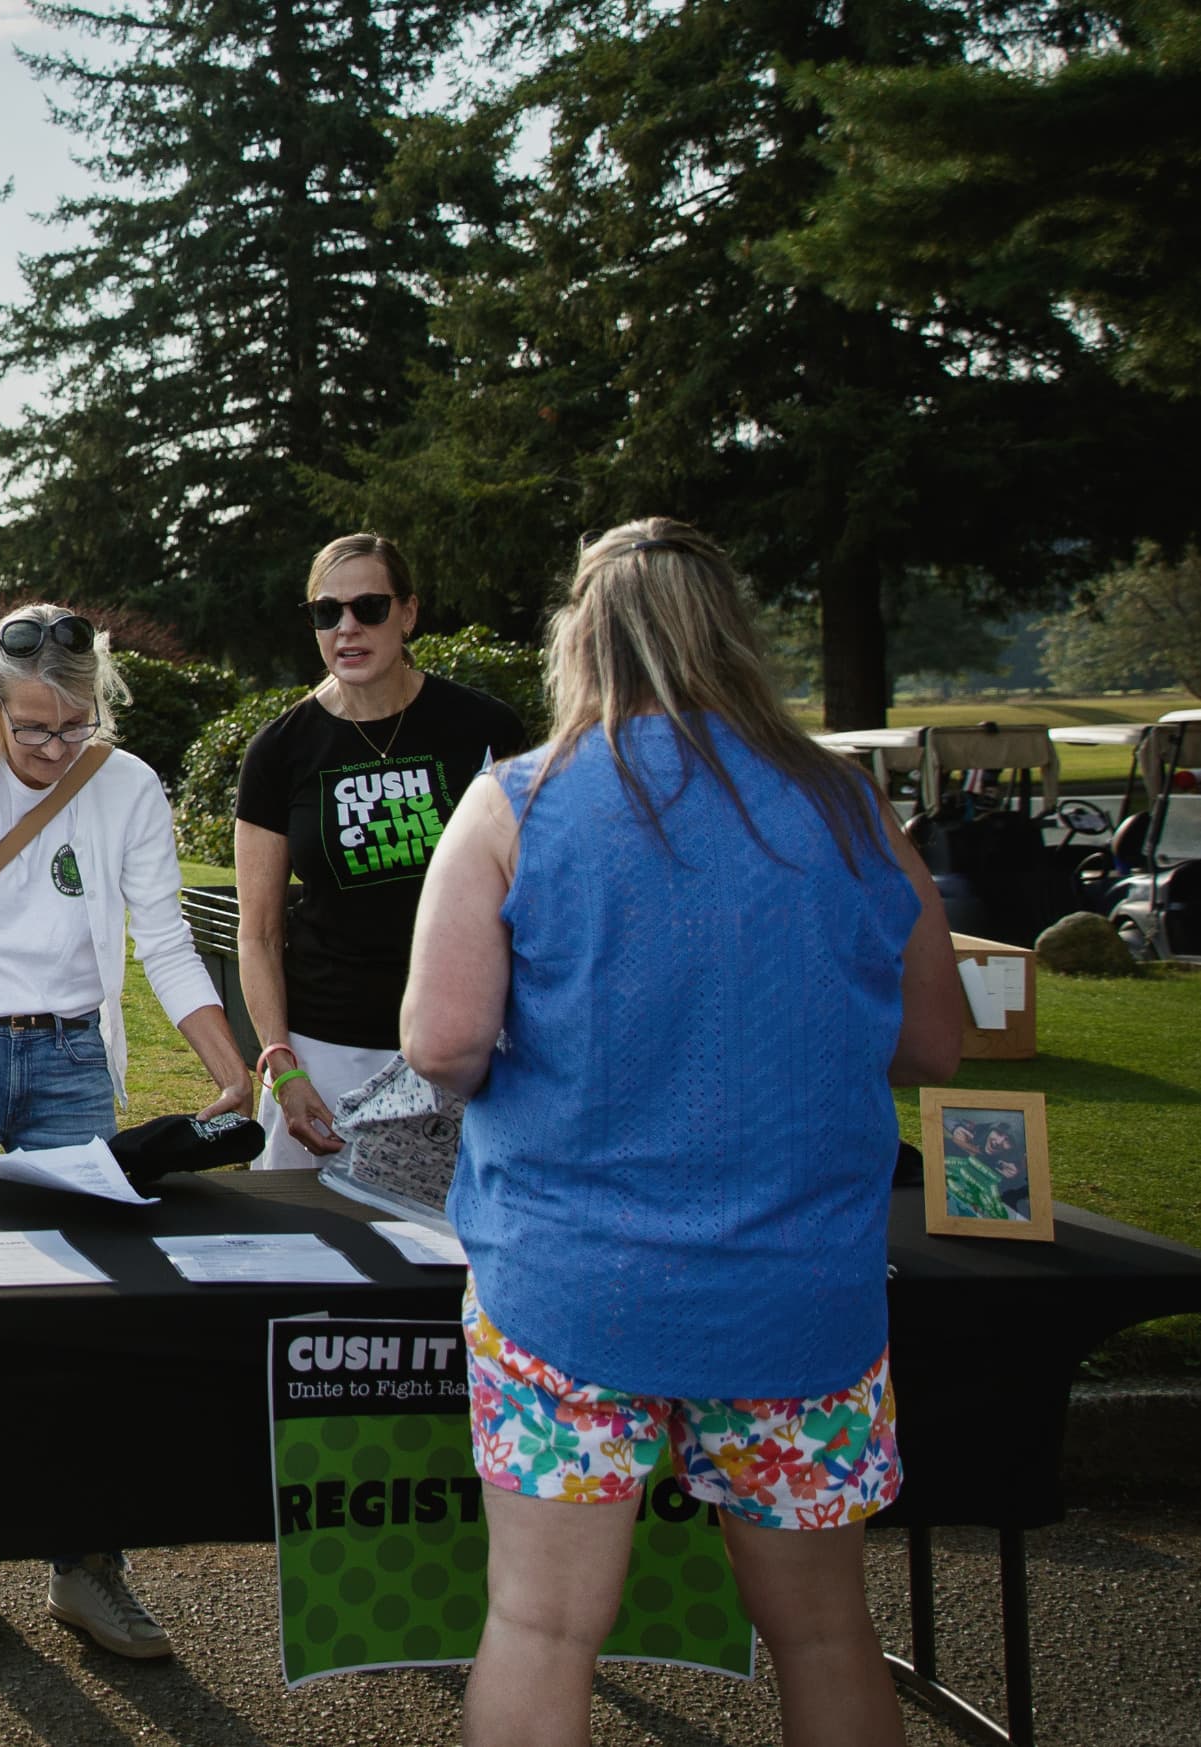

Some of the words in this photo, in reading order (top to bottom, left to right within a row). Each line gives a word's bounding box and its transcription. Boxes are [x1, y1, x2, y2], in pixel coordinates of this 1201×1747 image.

[334, 769, 431, 803] CUSH
[336, 802, 374, 826] IT
[381, 792, 434, 818] TO
[366, 808, 445, 845] THE
[288, 1336, 401, 1372] CUSH
[411, 1337, 457, 1370] IT
[287, 1382, 343, 1399] Unite
[350, 1381, 370, 1397] to
[376, 1380, 433, 1399] Fight
[437, 1380, 468, 1396] Ra
